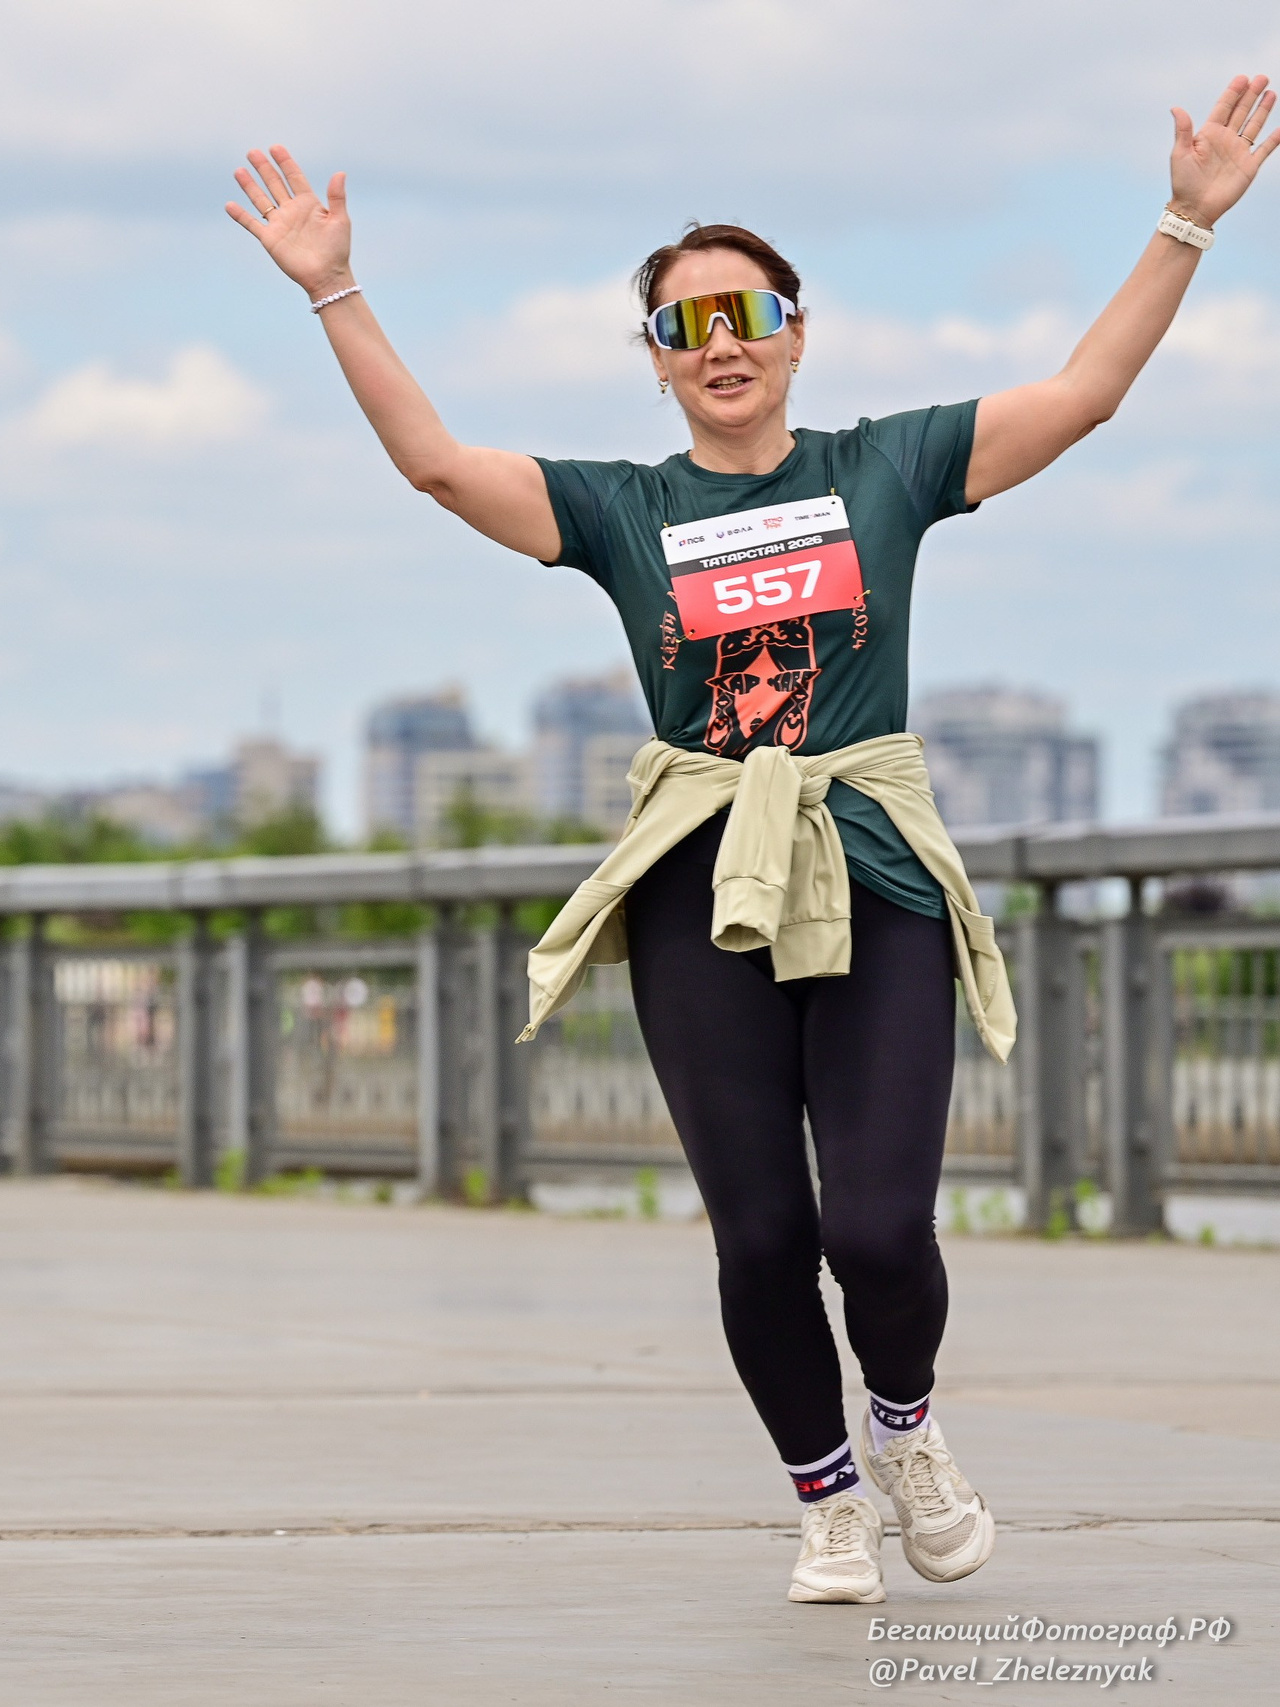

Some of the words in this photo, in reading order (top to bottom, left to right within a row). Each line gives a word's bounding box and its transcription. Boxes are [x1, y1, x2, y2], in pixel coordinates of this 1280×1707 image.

[687, 535, 705, 545] ПСБ
[699, 542, 786, 569] ТАТАРСТАН
[787, 535, 824, 551] 2026
[713, 559, 822, 615] 557
[851, 602, 869, 650] 2024
